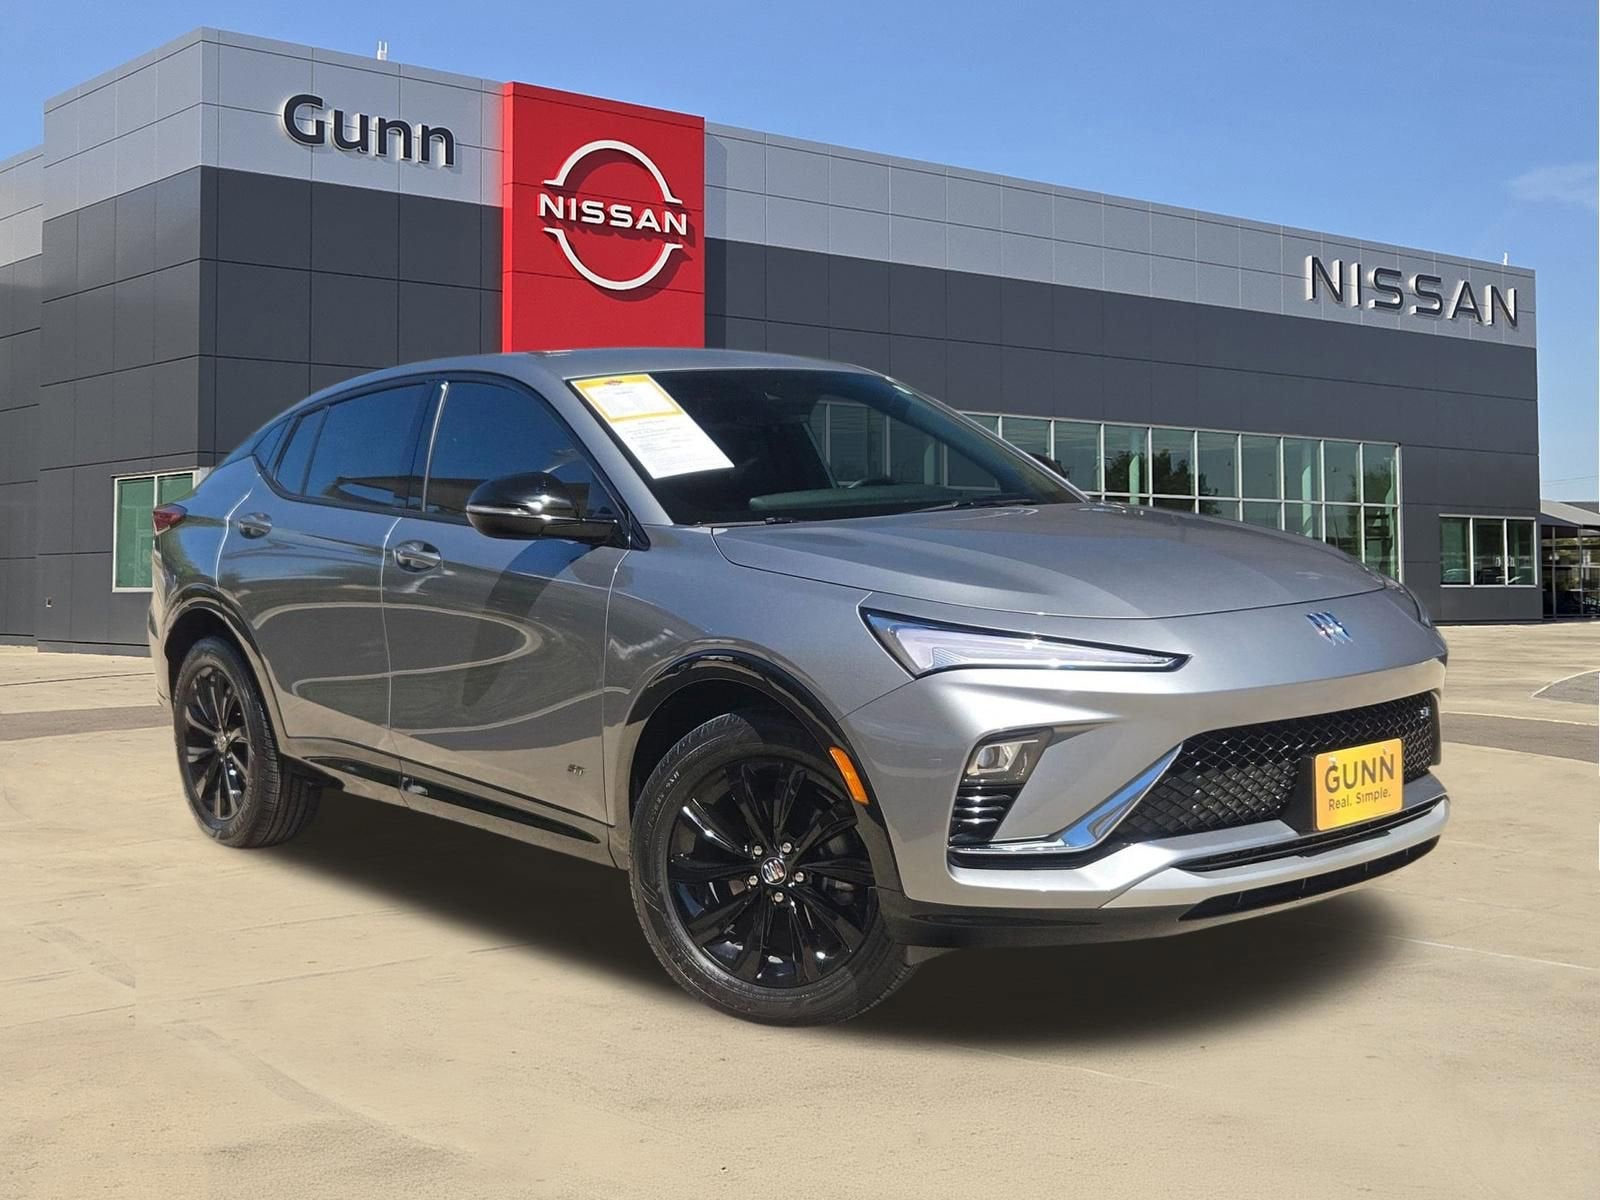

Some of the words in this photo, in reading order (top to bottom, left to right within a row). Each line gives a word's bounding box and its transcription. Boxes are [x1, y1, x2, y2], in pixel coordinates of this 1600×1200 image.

[282, 94, 455, 167] Gunn
[538, 193, 688, 235] NISSAN
[1304, 255, 1518, 327] NISSAN
[1325, 754, 1394, 793] GUNN
[1328, 794, 1353, 811] Real.
[1355, 787, 1391, 804] Simple.
